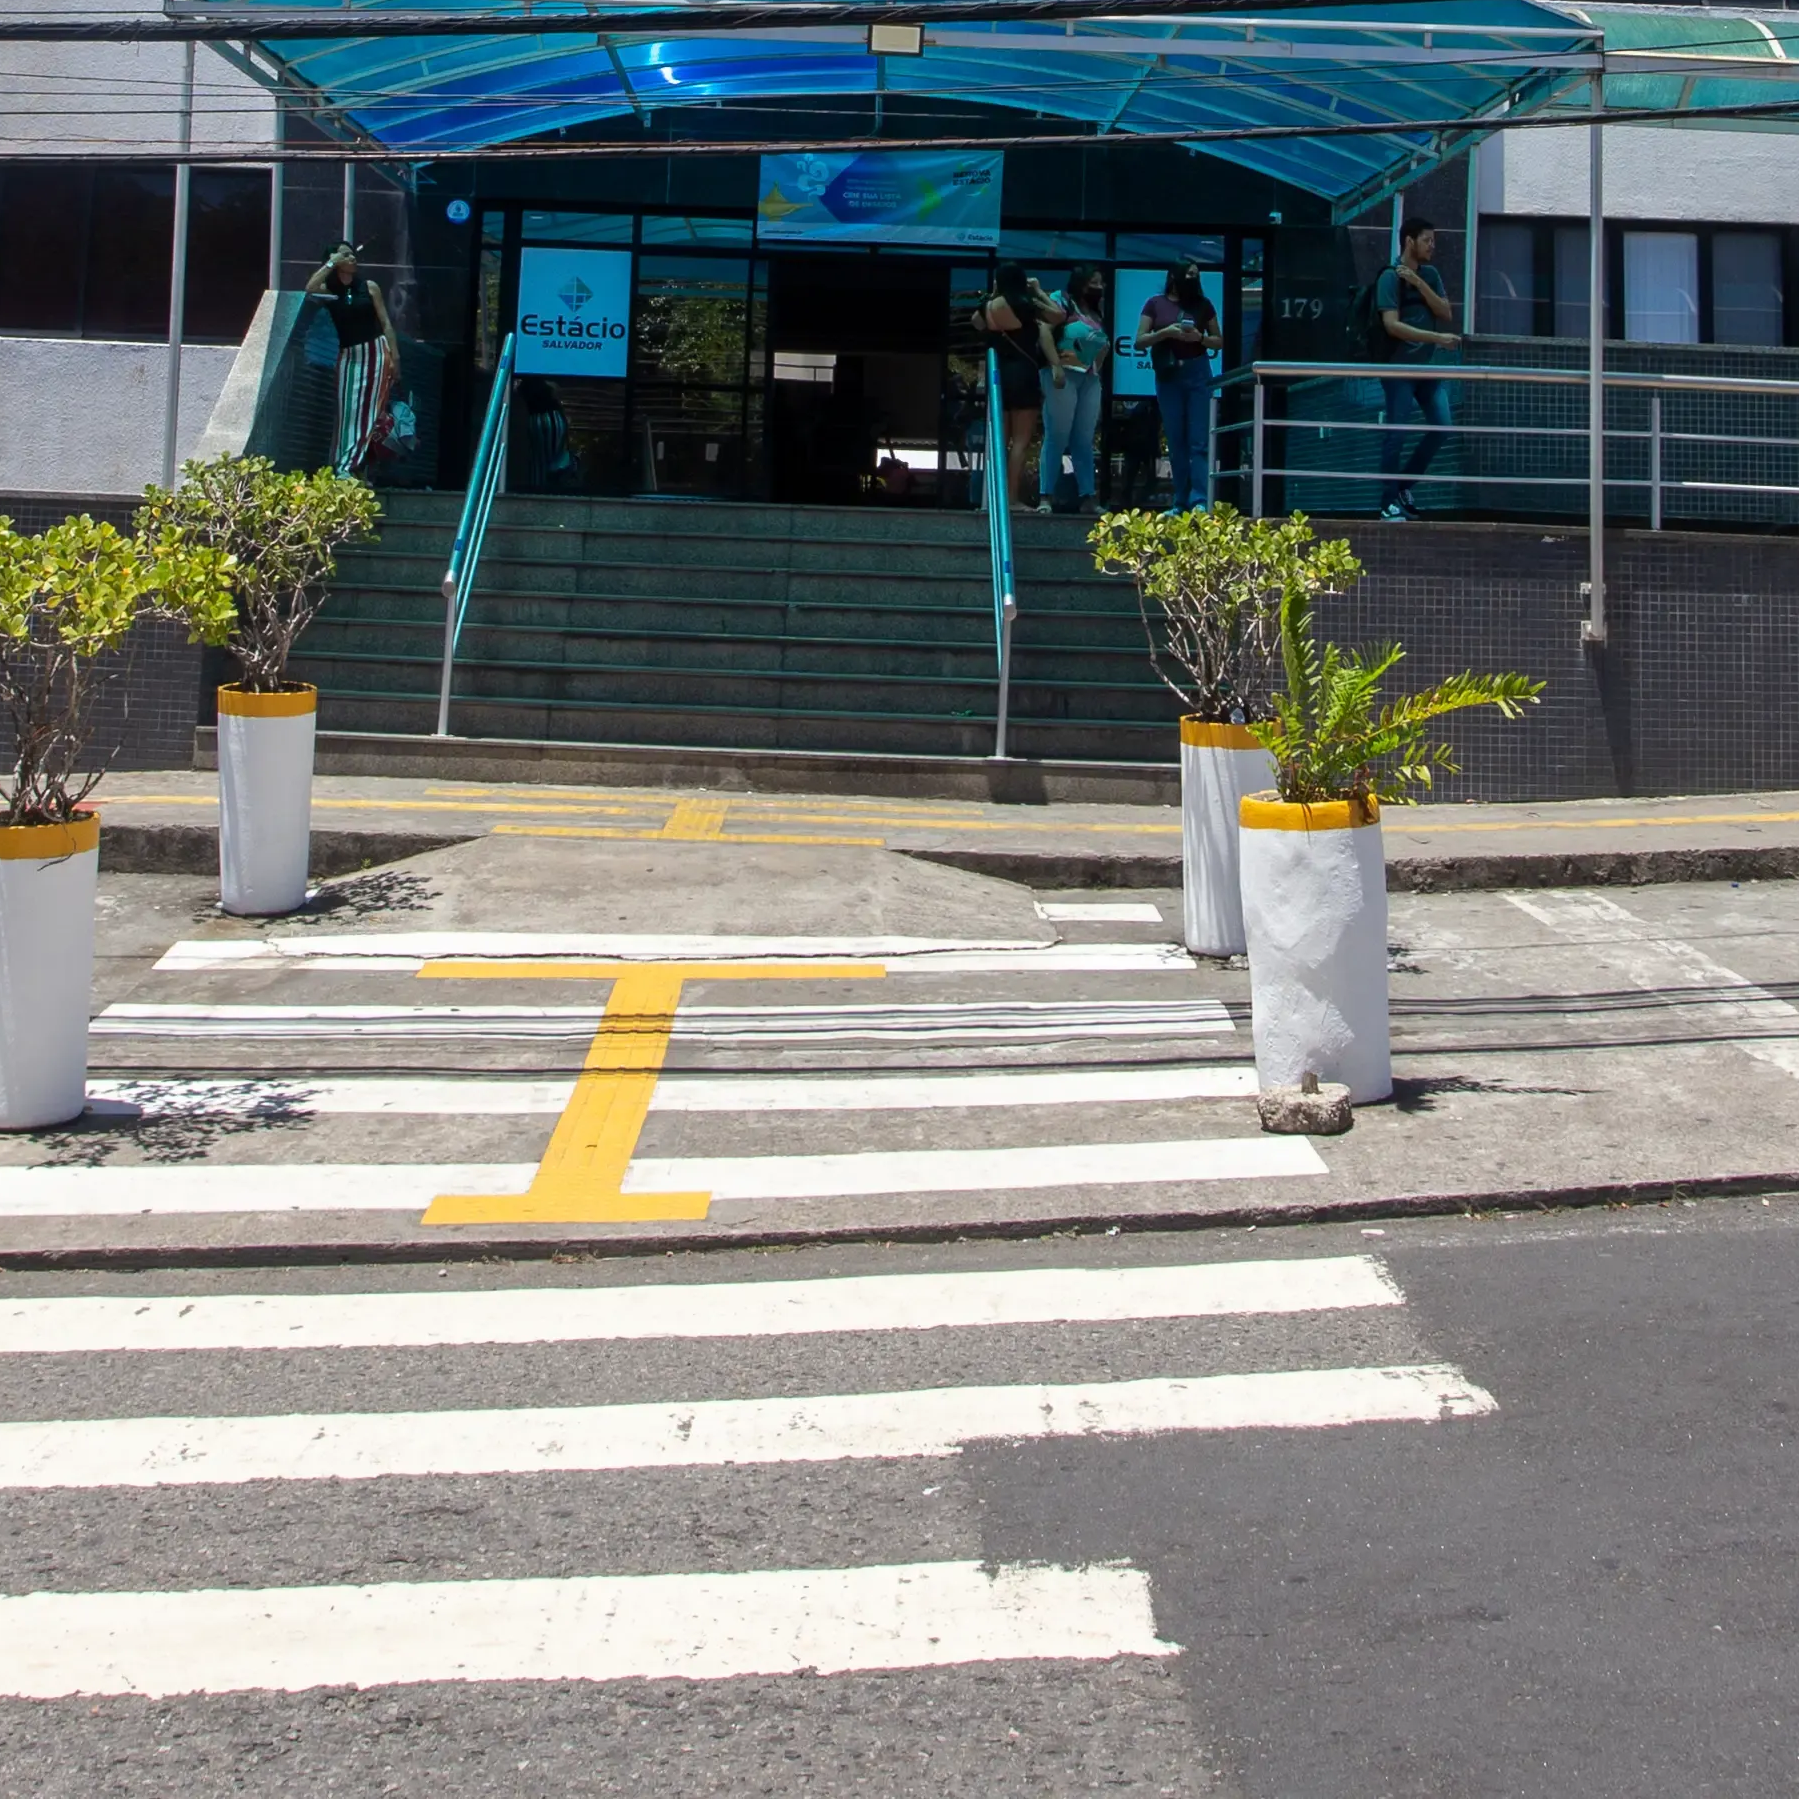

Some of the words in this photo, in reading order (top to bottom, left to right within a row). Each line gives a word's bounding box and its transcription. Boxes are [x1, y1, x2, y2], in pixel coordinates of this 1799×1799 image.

[1281, 298, 1323, 320] 179
[521, 314, 626, 339] Estácio
[542, 339, 603, 350] SALVADOR
